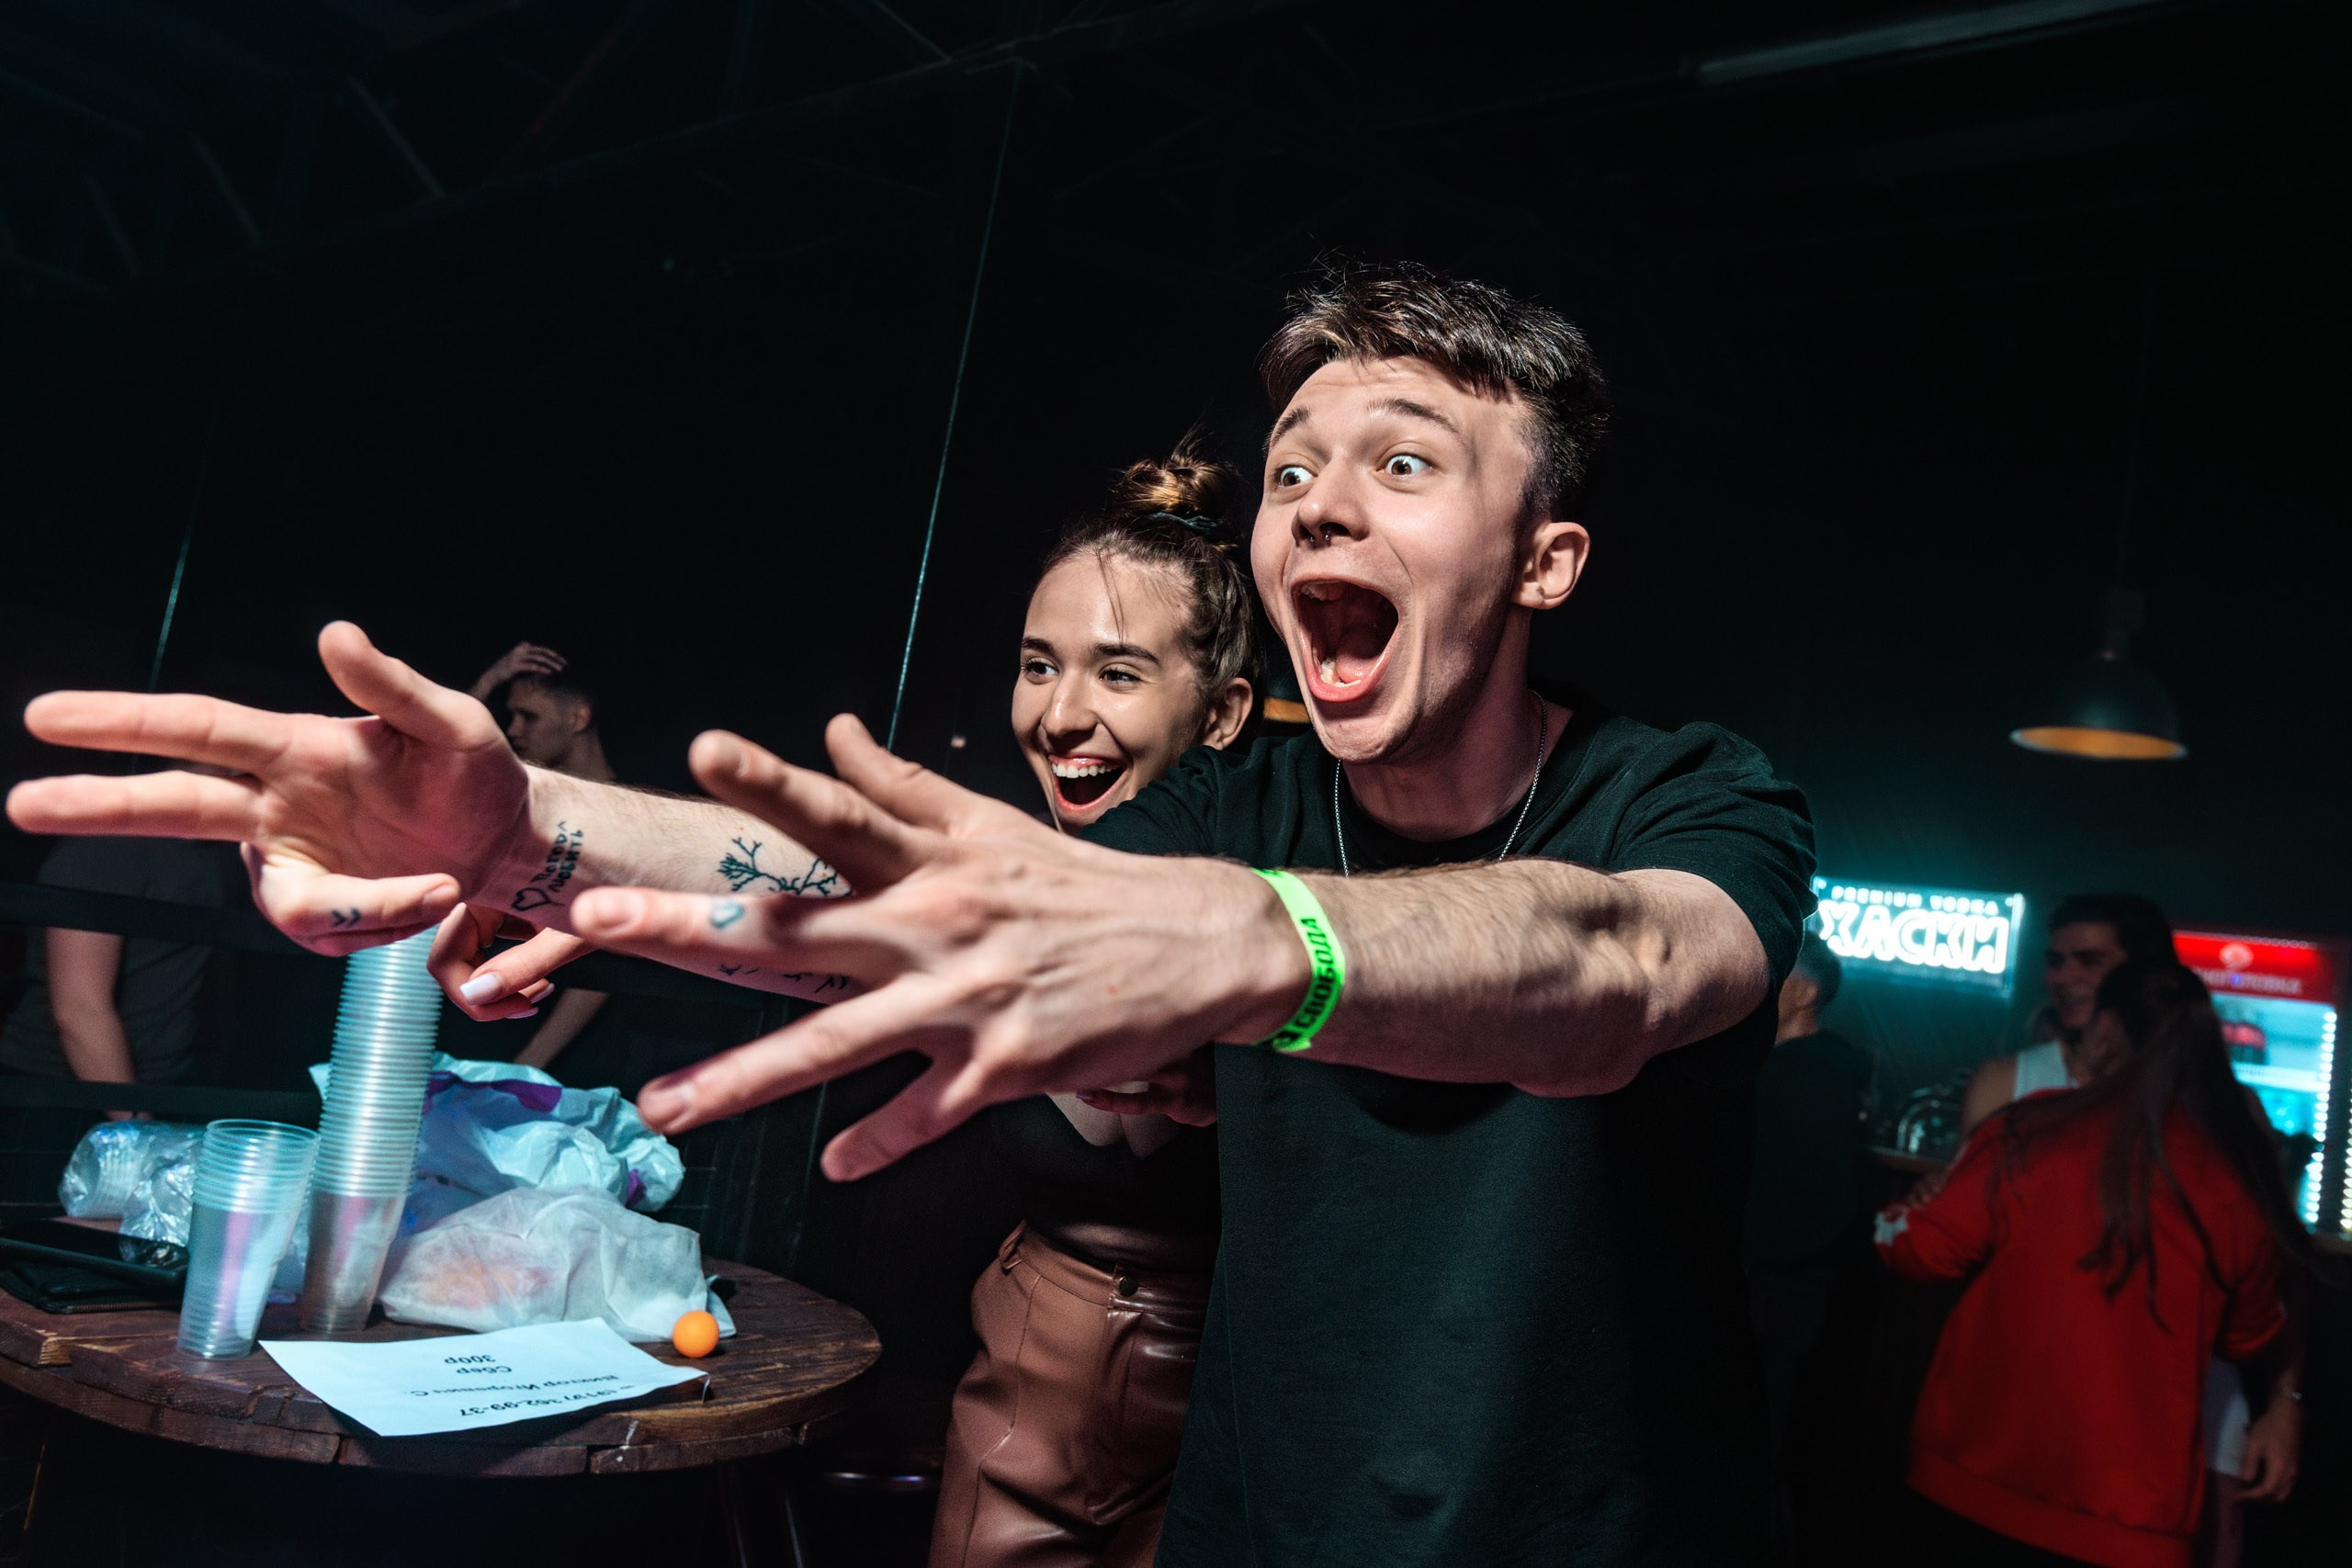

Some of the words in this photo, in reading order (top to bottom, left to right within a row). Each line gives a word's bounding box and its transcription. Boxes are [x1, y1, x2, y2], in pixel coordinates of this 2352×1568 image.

[1831, 886, 1922, 908] PREMIUM
[1929, 895, 1999, 916] VODKA
[456, 1365, 513, 1374] Сбер
